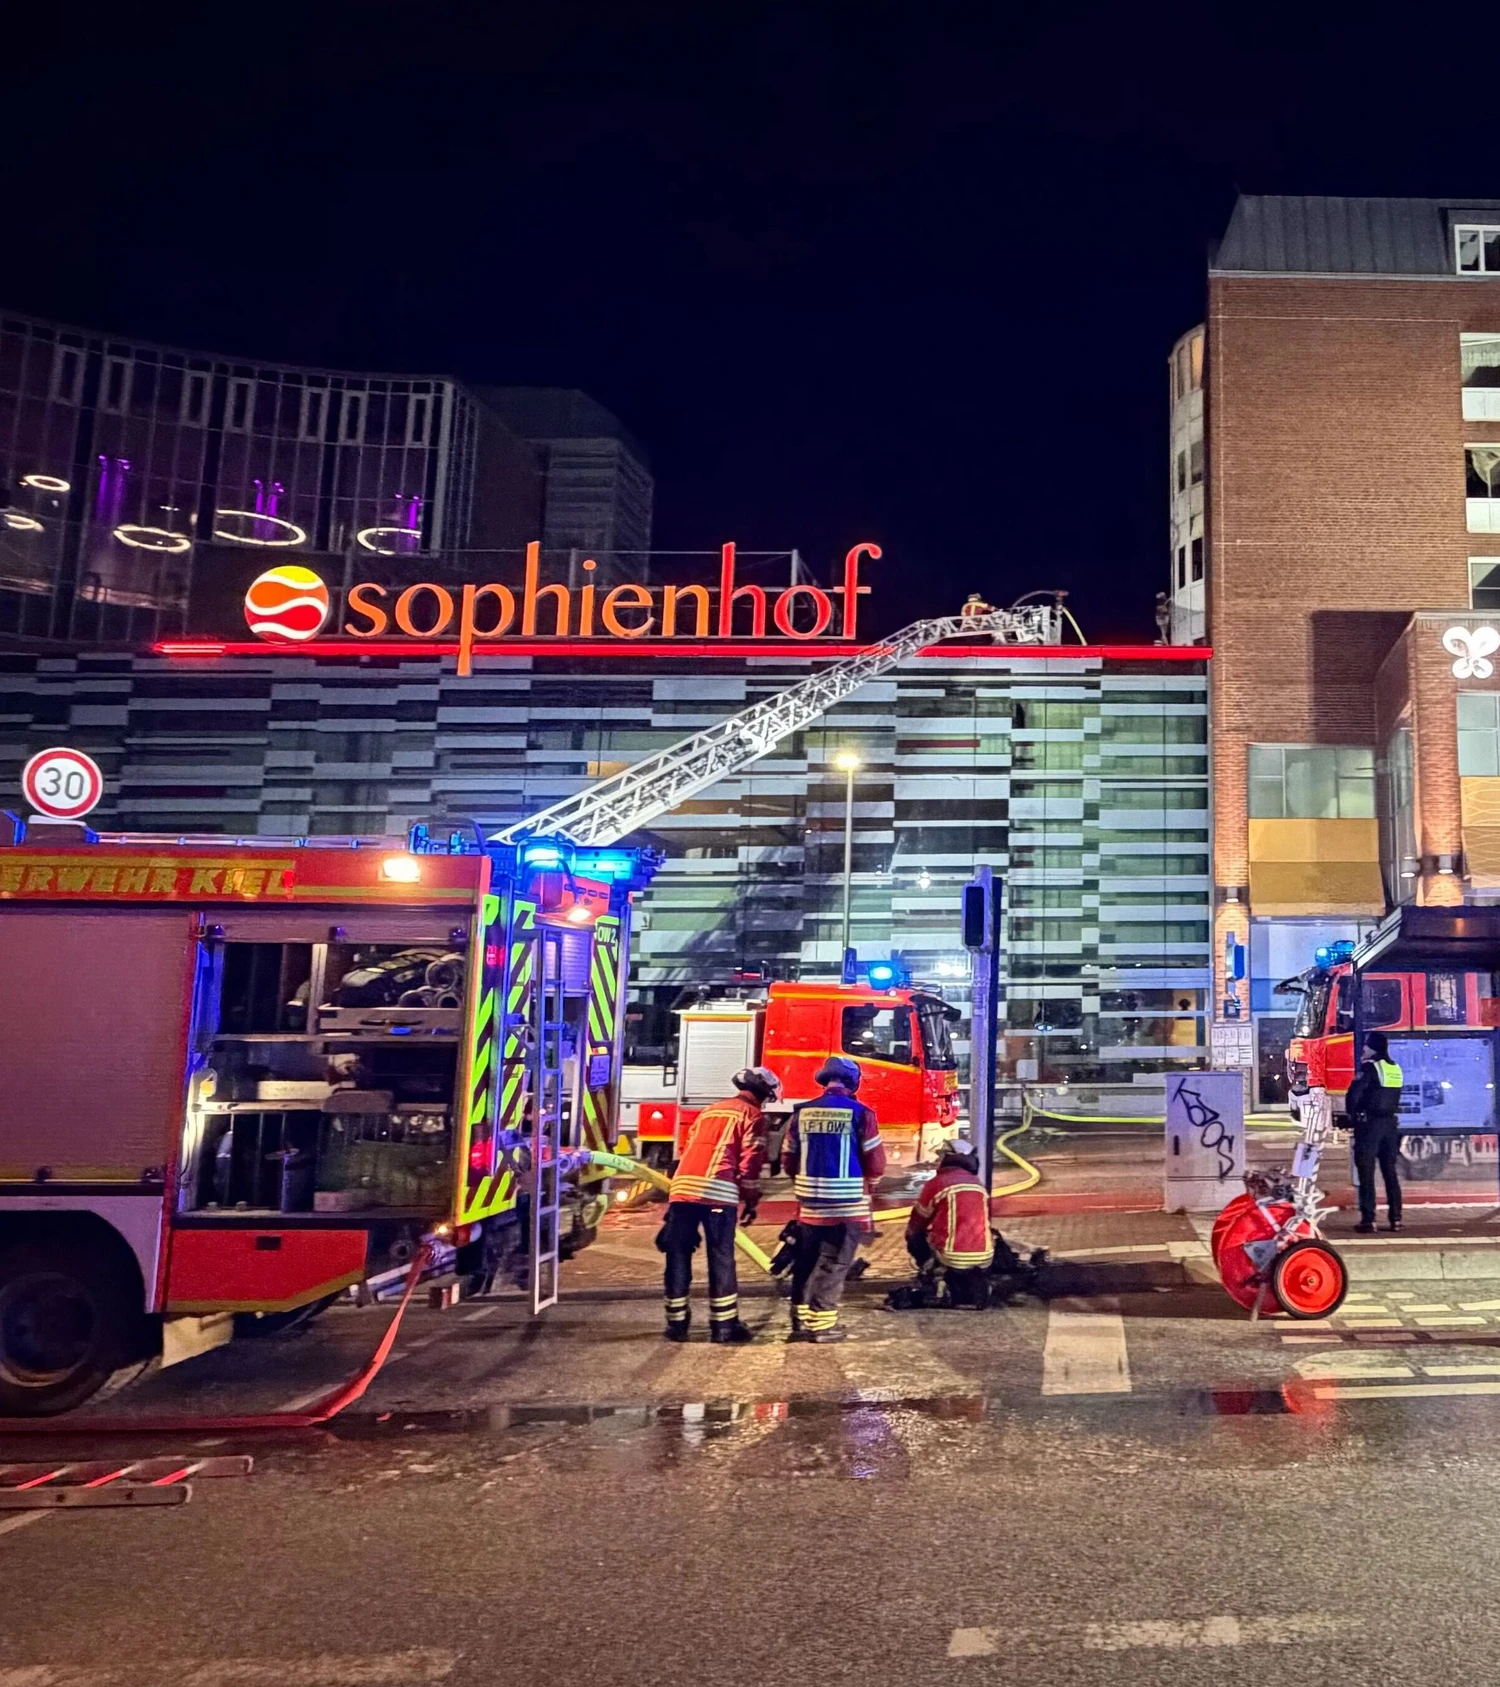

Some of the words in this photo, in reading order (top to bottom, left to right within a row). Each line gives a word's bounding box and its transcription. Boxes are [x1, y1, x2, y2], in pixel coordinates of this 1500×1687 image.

[344, 540, 884, 676] sophienhof
[41, 767, 84, 800] 30
[190, 867, 294, 896] KIEL
